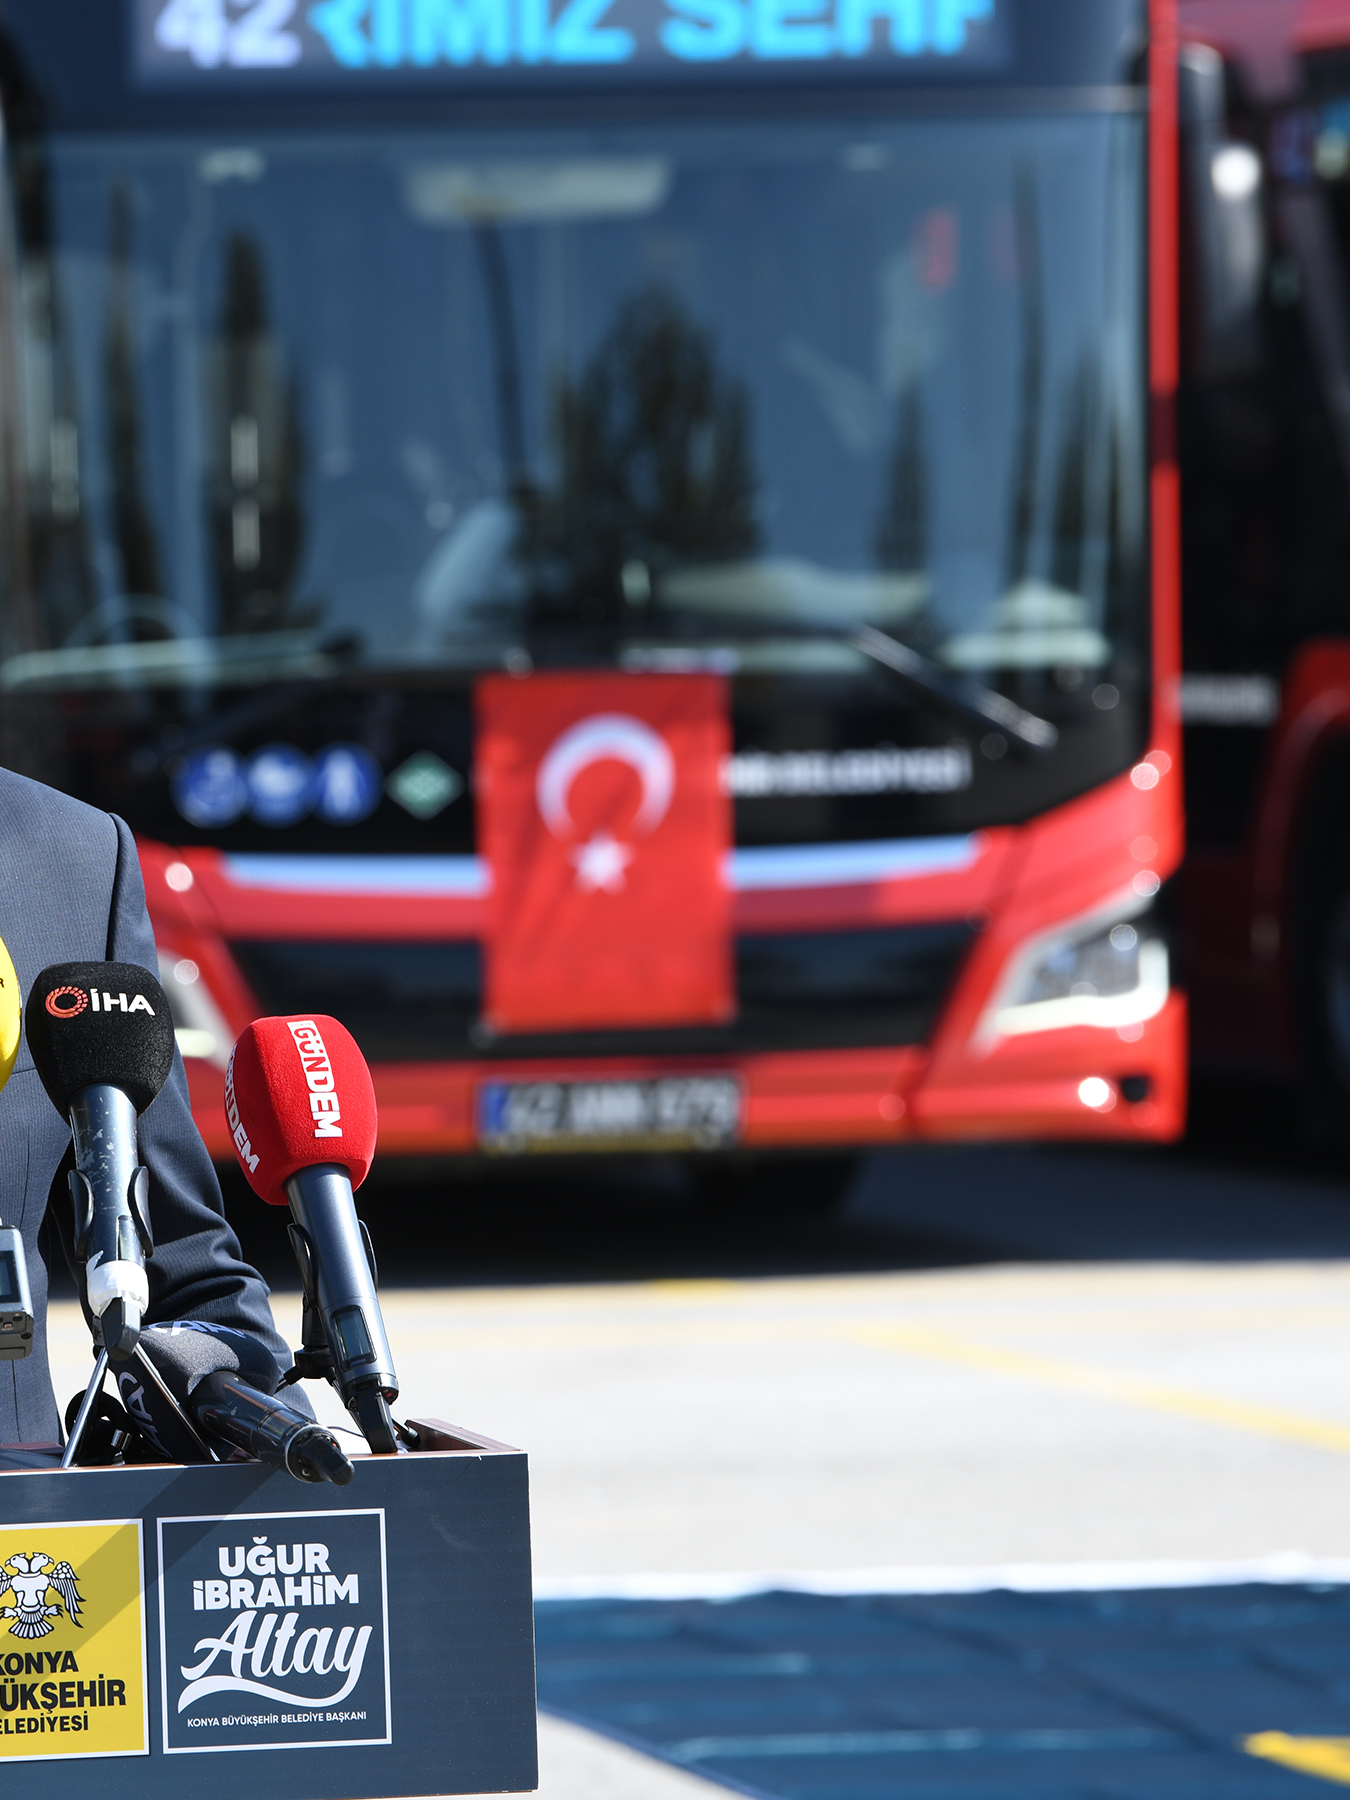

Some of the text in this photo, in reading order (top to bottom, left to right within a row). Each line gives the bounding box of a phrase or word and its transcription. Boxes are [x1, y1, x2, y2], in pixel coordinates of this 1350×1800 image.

[293, 1027, 343, 1138] GÜNDEM
[218, 1536, 331, 1577] UĞUR
[177, 1610, 373, 1714] Altay
[187, 1711, 367, 1728] KONYA BÜYÜKŞEHİR BELEDİYE BAŞKANI
